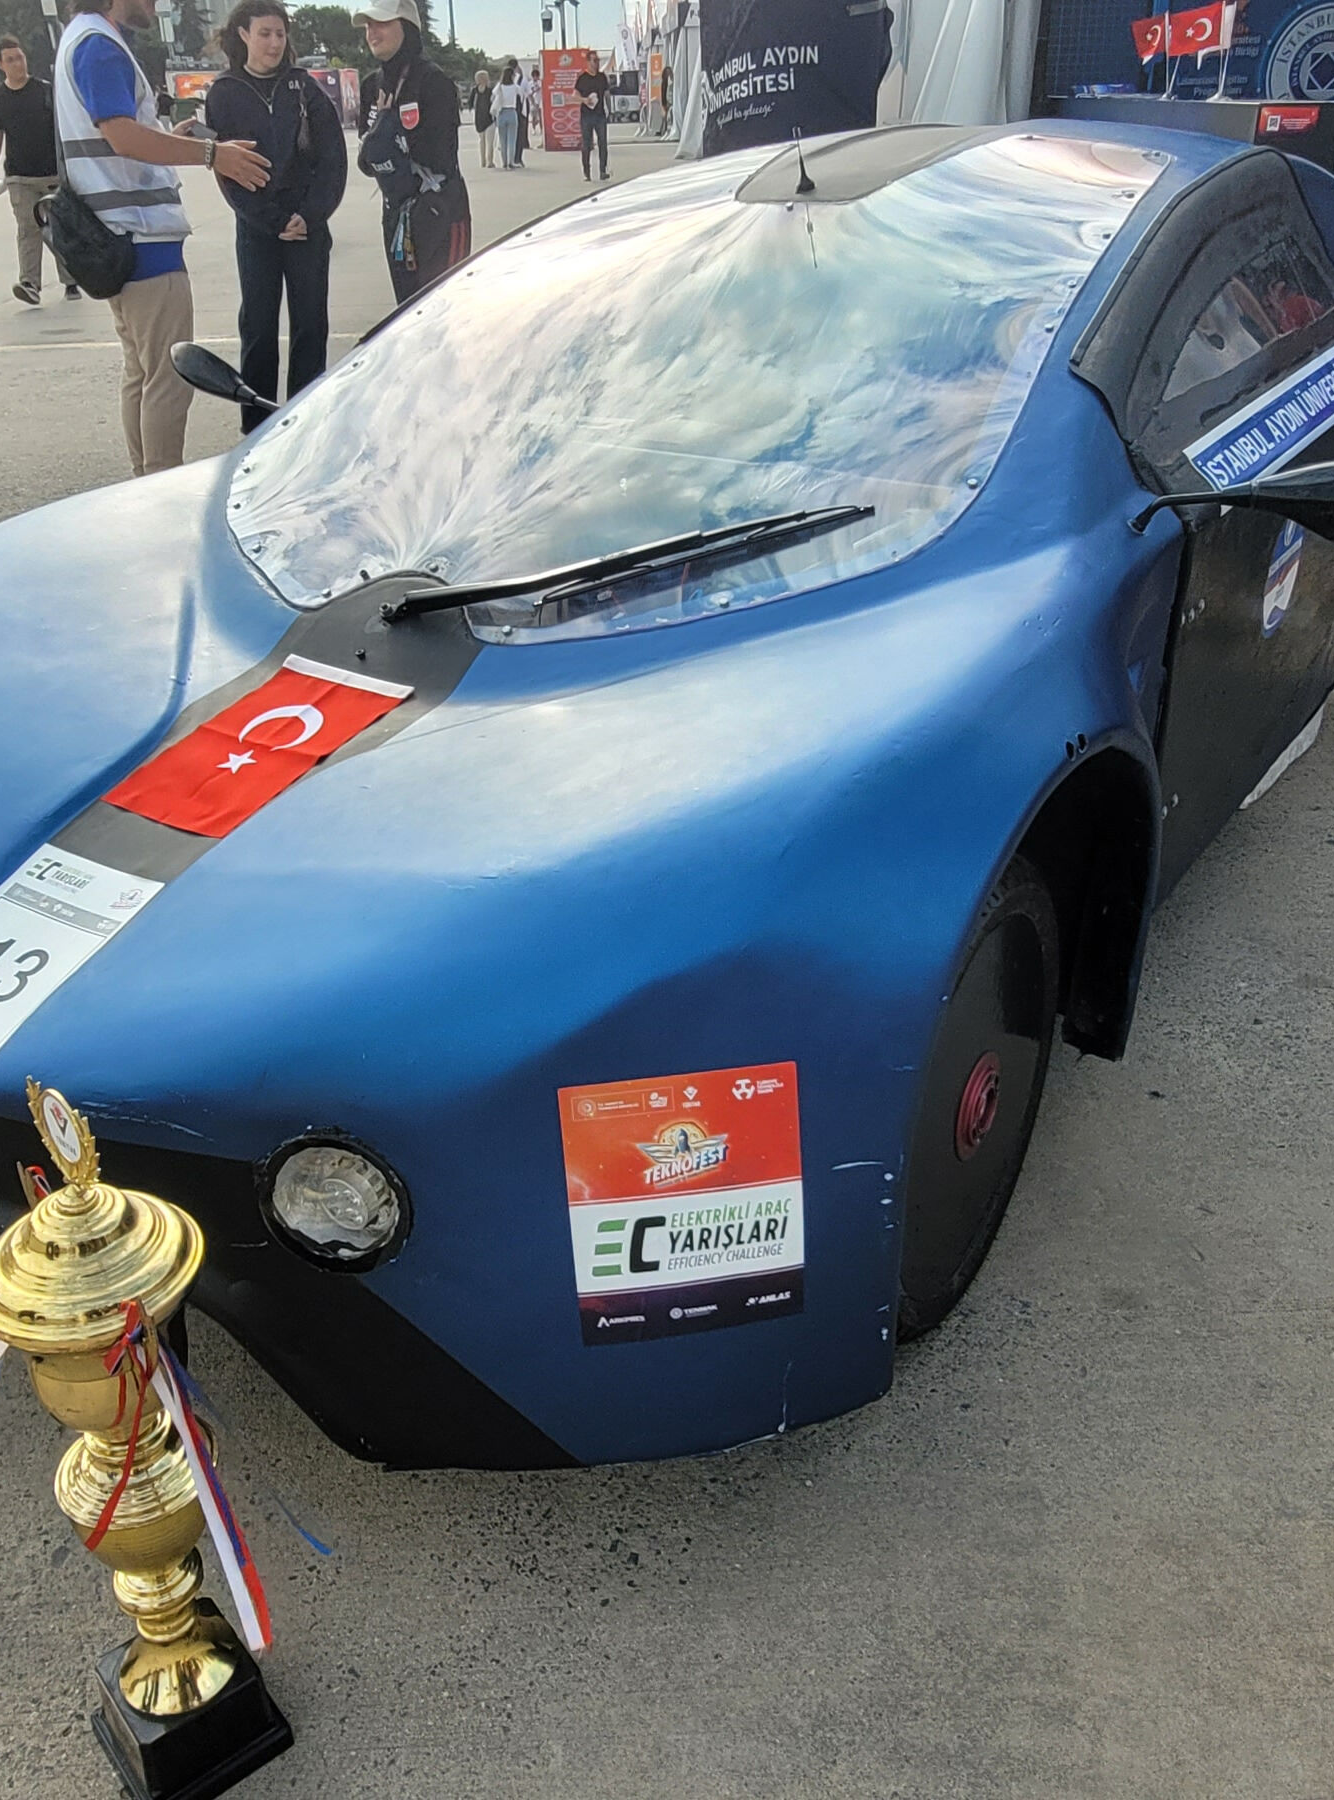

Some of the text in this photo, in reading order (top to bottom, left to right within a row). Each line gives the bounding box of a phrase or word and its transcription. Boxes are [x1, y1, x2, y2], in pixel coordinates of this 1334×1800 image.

[762, 45, 818, 67] AYDIN
[1197, 426, 1276, 492] İSTANBUL
[1264, 398, 1308, 444] AYDIN
[643, 1143, 729, 1185] TEKNOFEST
[671, 1203, 751, 1228] ELEKTRİKLİ
[668, 1215, 788, 1255] YARIŞLARI
[667, 1242, 784, 1271] EFFICIENCY CHALLENGE
